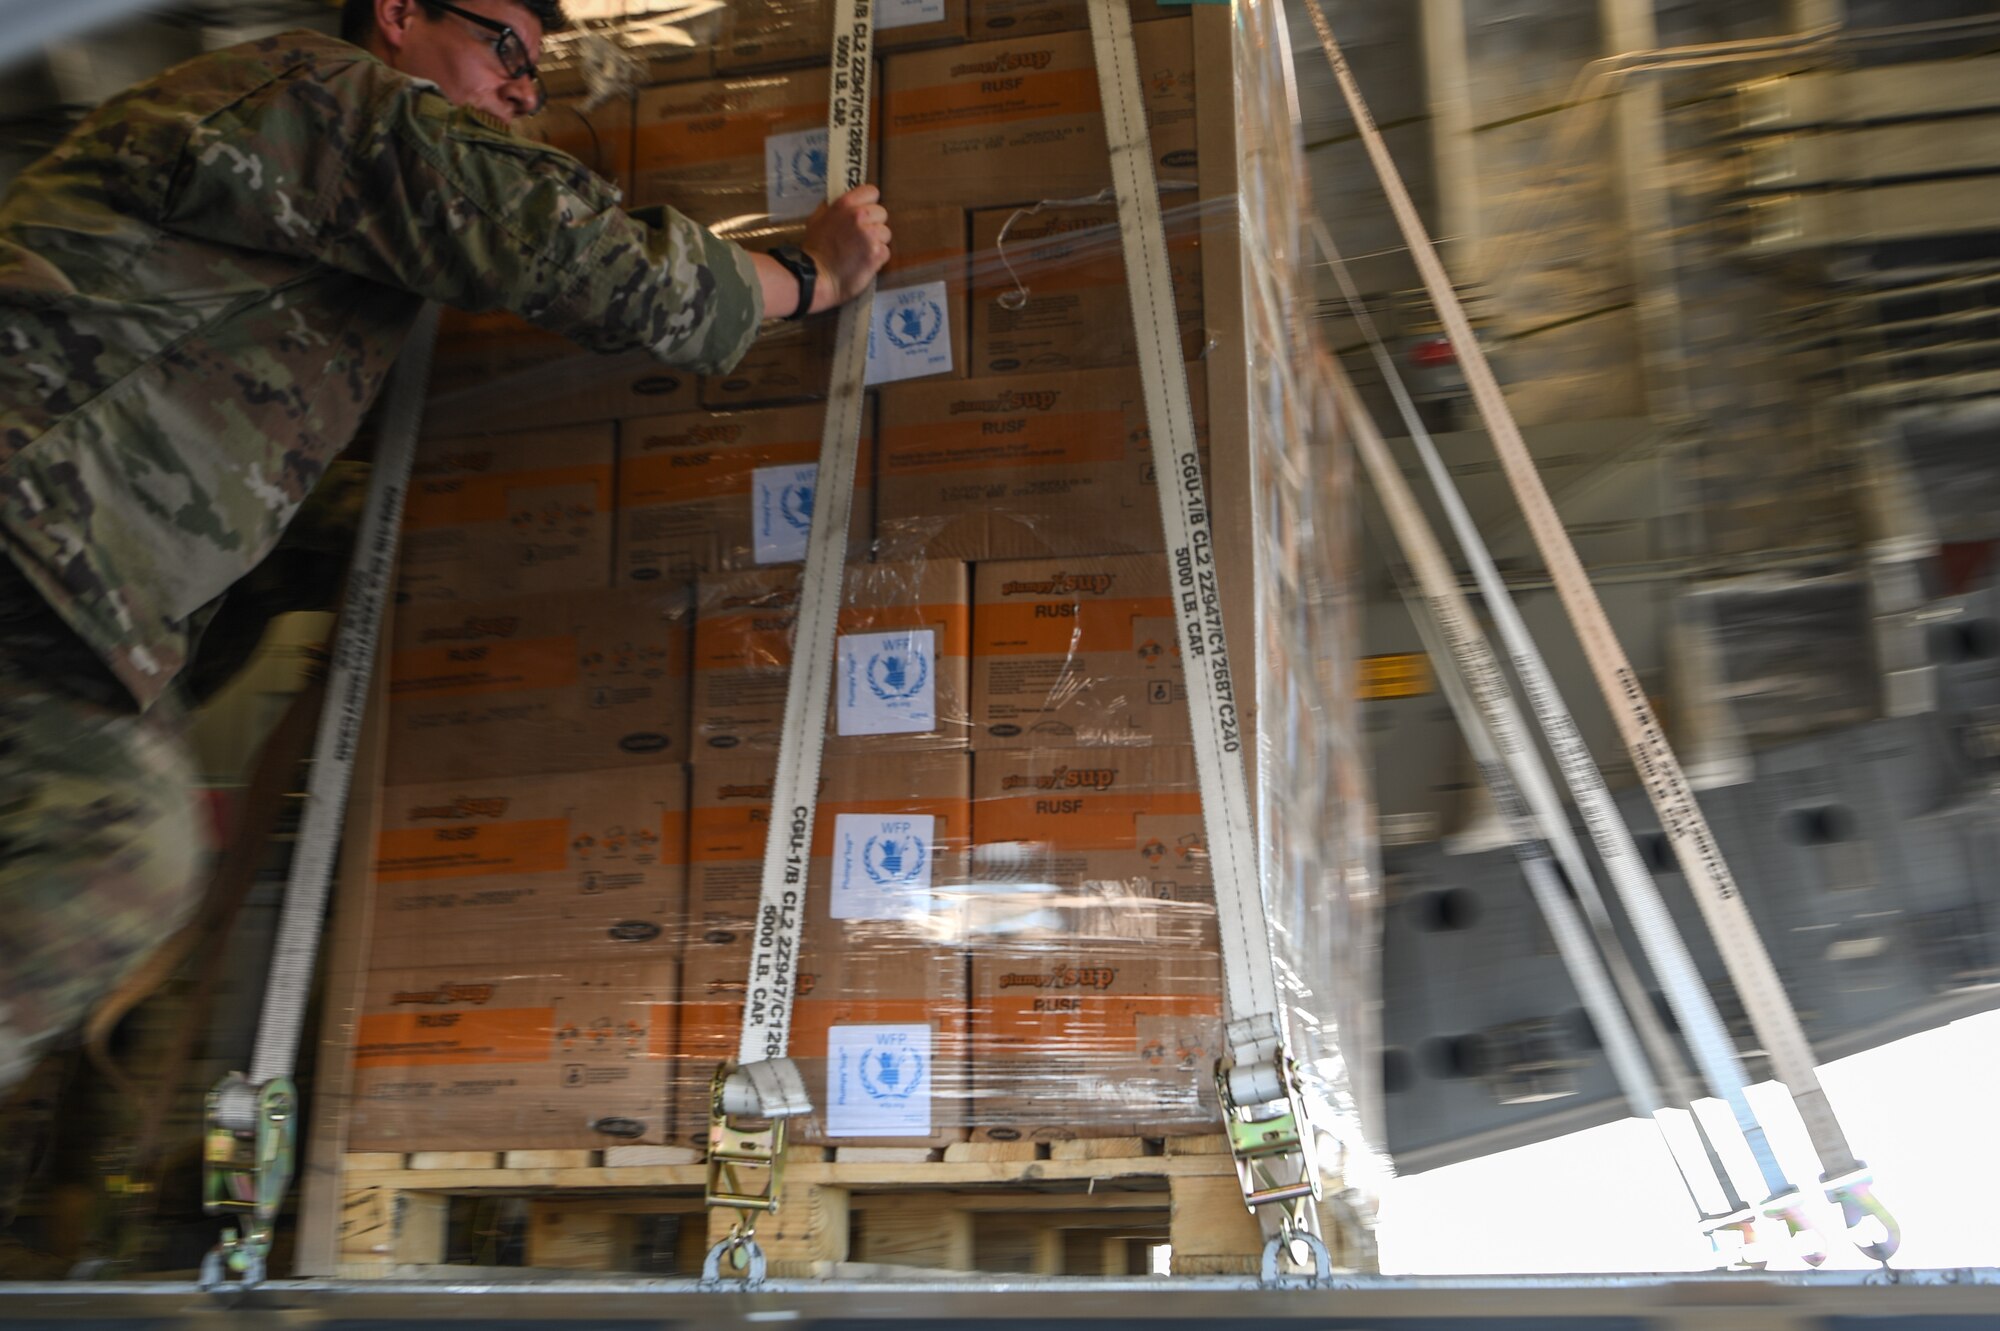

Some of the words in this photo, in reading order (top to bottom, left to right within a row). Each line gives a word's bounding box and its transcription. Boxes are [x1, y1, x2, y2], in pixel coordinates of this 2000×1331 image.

[981, 77, 1024, 94] RUSF
[982, 419, 1026, 435] RUSF
[1180, 452, 1205, 526] CGU-1/B
[1175, 546, 1194, 587] 5000
[1192, 529, 1211, 566] CL2
[1181, 591, 1198, 619] LB.
[1187, 621, 1205, 660] CAP.
[1036, 800, 1083, 814] RUSF
[786, 806, 808, 885] CGU-1/B
[881, 823, 911, 834] WFP
[761, 905, 777, 948] 5000
[780, 890, 798, 929] CL2
[756, 953, 771, 982] LB.
[750, 987, 767, 1027] CAP.
[765, 935, 793, 1059] 2Z947/C126
[876, 1034, 906, 1045] WFP
